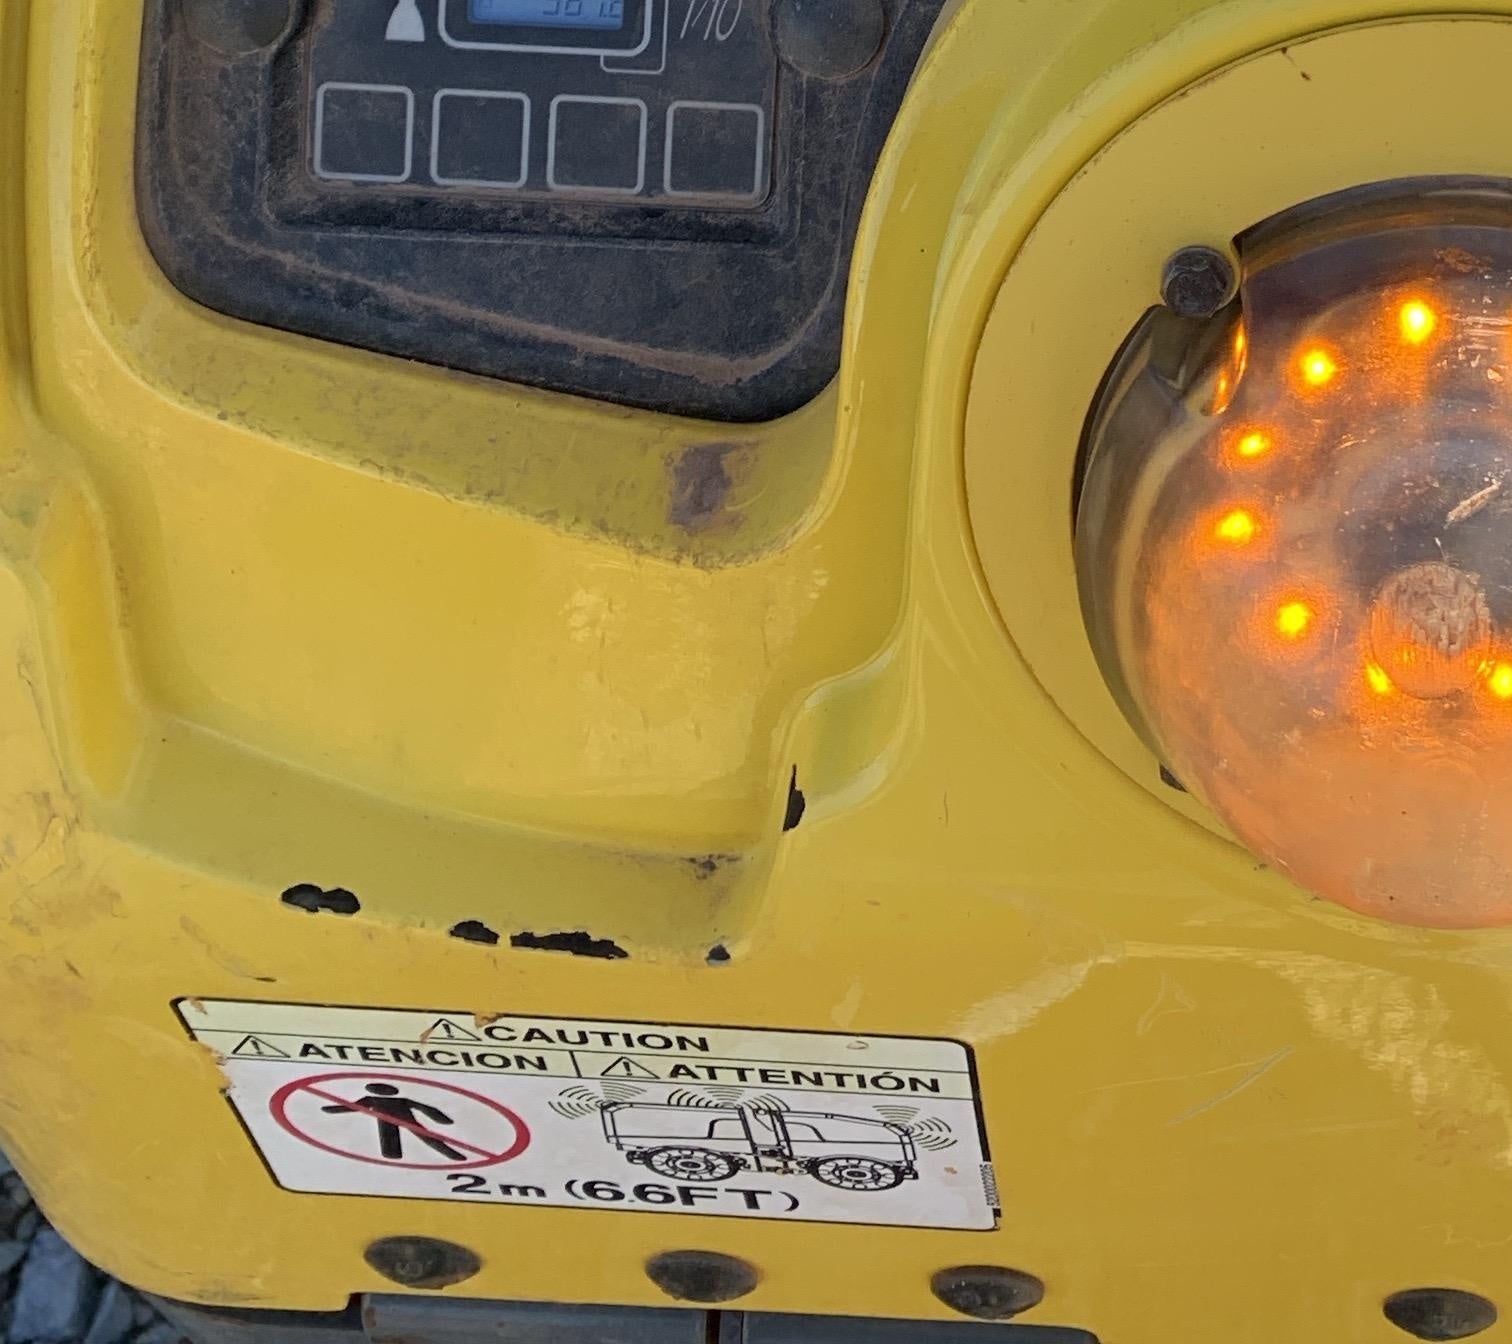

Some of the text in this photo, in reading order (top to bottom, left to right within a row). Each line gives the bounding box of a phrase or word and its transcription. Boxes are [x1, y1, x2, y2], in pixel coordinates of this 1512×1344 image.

[483, 1024, 710, 1054] CAUTION
[297, 1041, 547, 1073] ATENCION
[668, 1060, 940, 1095] ATTENTIÓN
